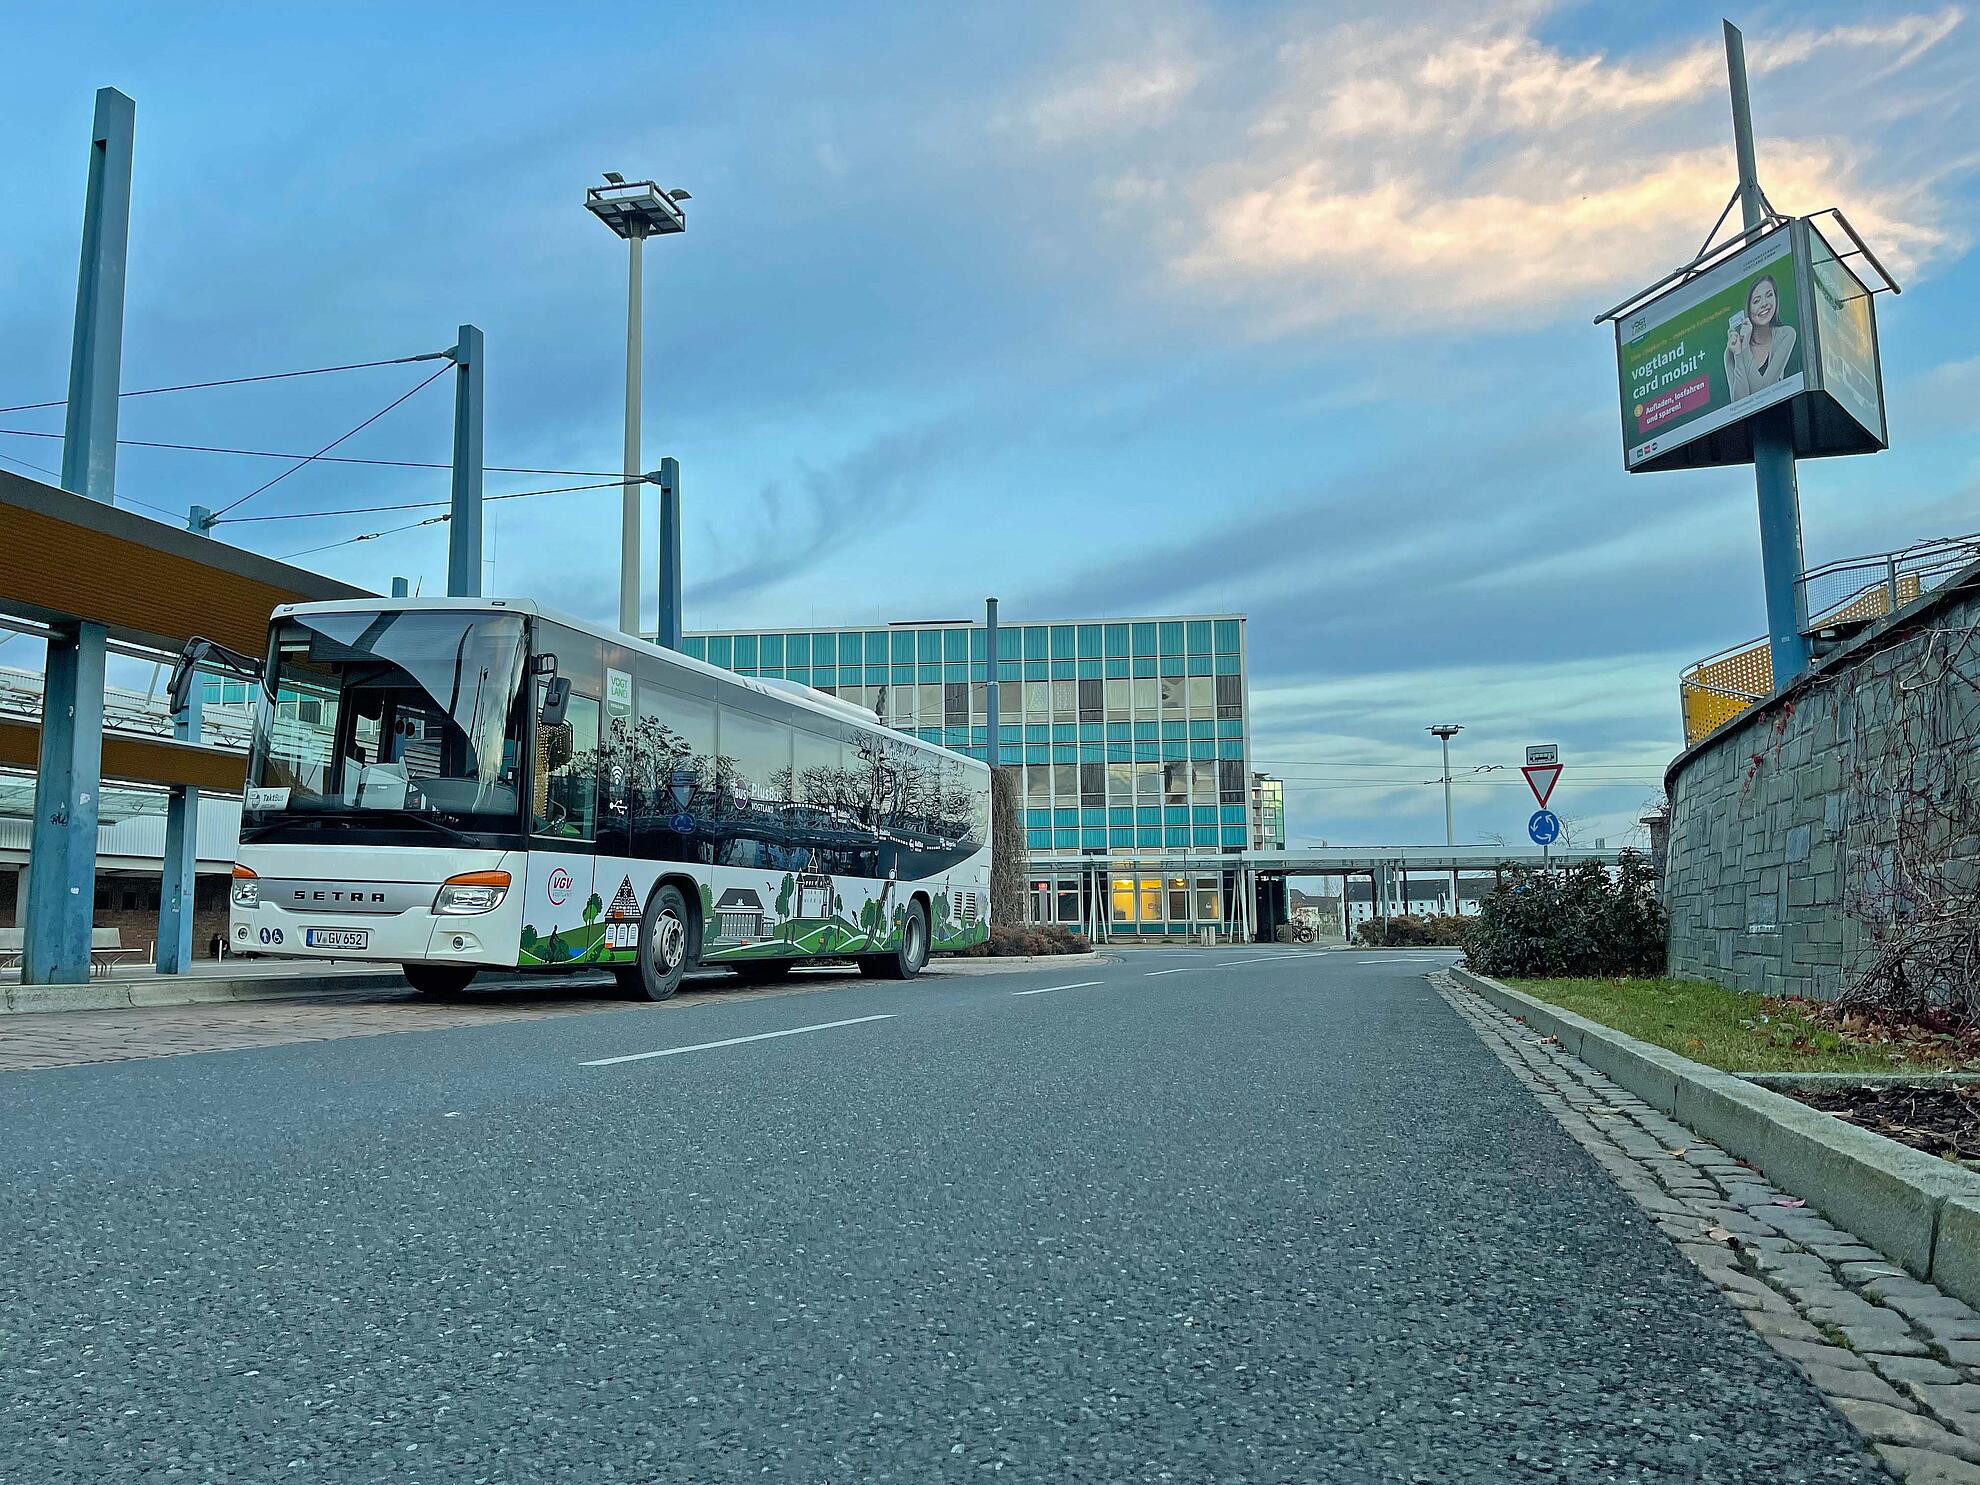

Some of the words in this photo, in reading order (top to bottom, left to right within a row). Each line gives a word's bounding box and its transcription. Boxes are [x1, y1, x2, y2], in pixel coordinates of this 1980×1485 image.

[1632, 341, 1685, 380] vogtland
[1633, 375, 1658, 399] card
[1646, 397, 1674, 415] Aufladen,
[1675, 382, 1705, 401] losfahren
[1646, 412, 1658, 424] und
[1659, 402, 1681, 421] sparen!
[611, 676, 628, 688] VOGT
[612, 687, 627, 699] LAND
[263, 793, 285, 802] TaktBus
[735, 788, 747, 800] BUS
[751, 783, 783, 803] PlusBus
[751, 803, 775, 813] VOGTLAND
[553, 877, 573, 889] VGV
[294, 891, 385, 902] SETRA
[316, 932, 322, 943] V
